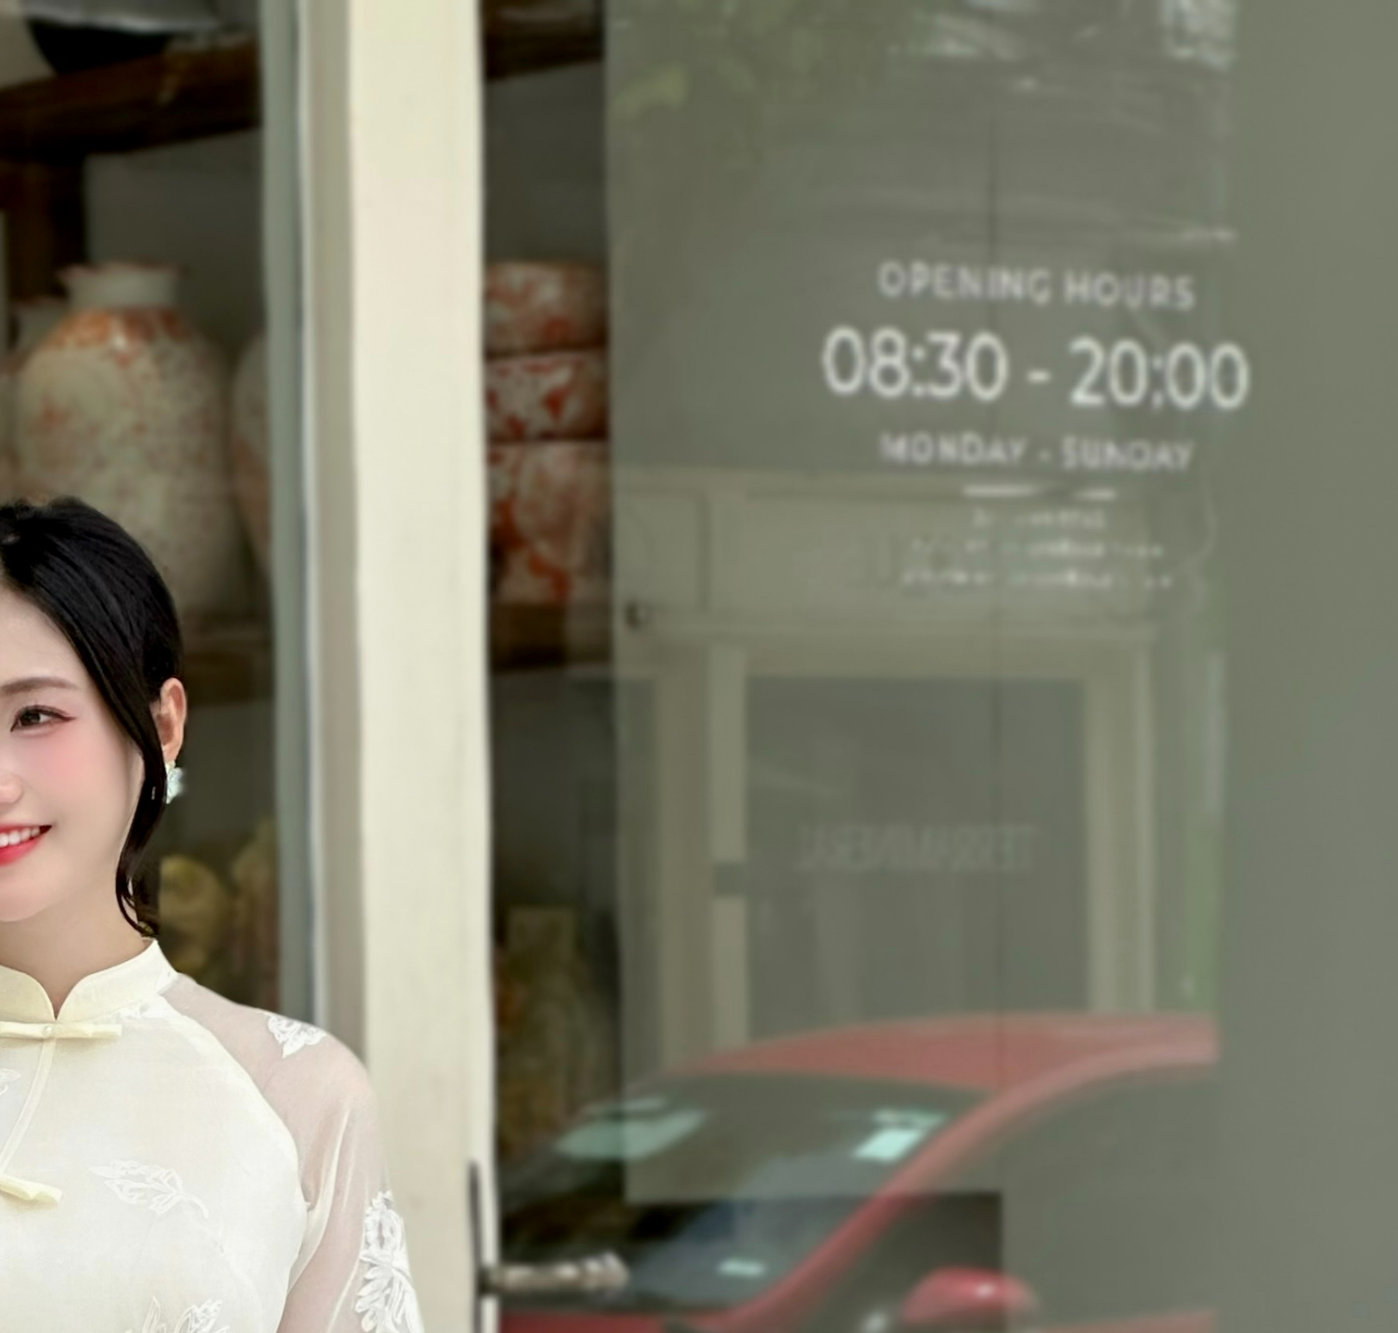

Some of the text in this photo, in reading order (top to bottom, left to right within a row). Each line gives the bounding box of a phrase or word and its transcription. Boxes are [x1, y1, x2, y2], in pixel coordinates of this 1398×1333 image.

[878, 262, 1196, 311] OPENING HOURS
[822, 325, 1008, 402] 08:30
[1069, 333, 1251, 410] 20:00
[879, 431, 1027, 466] MONDAY
[1061, 434, 1193, 474] SUNDAY
